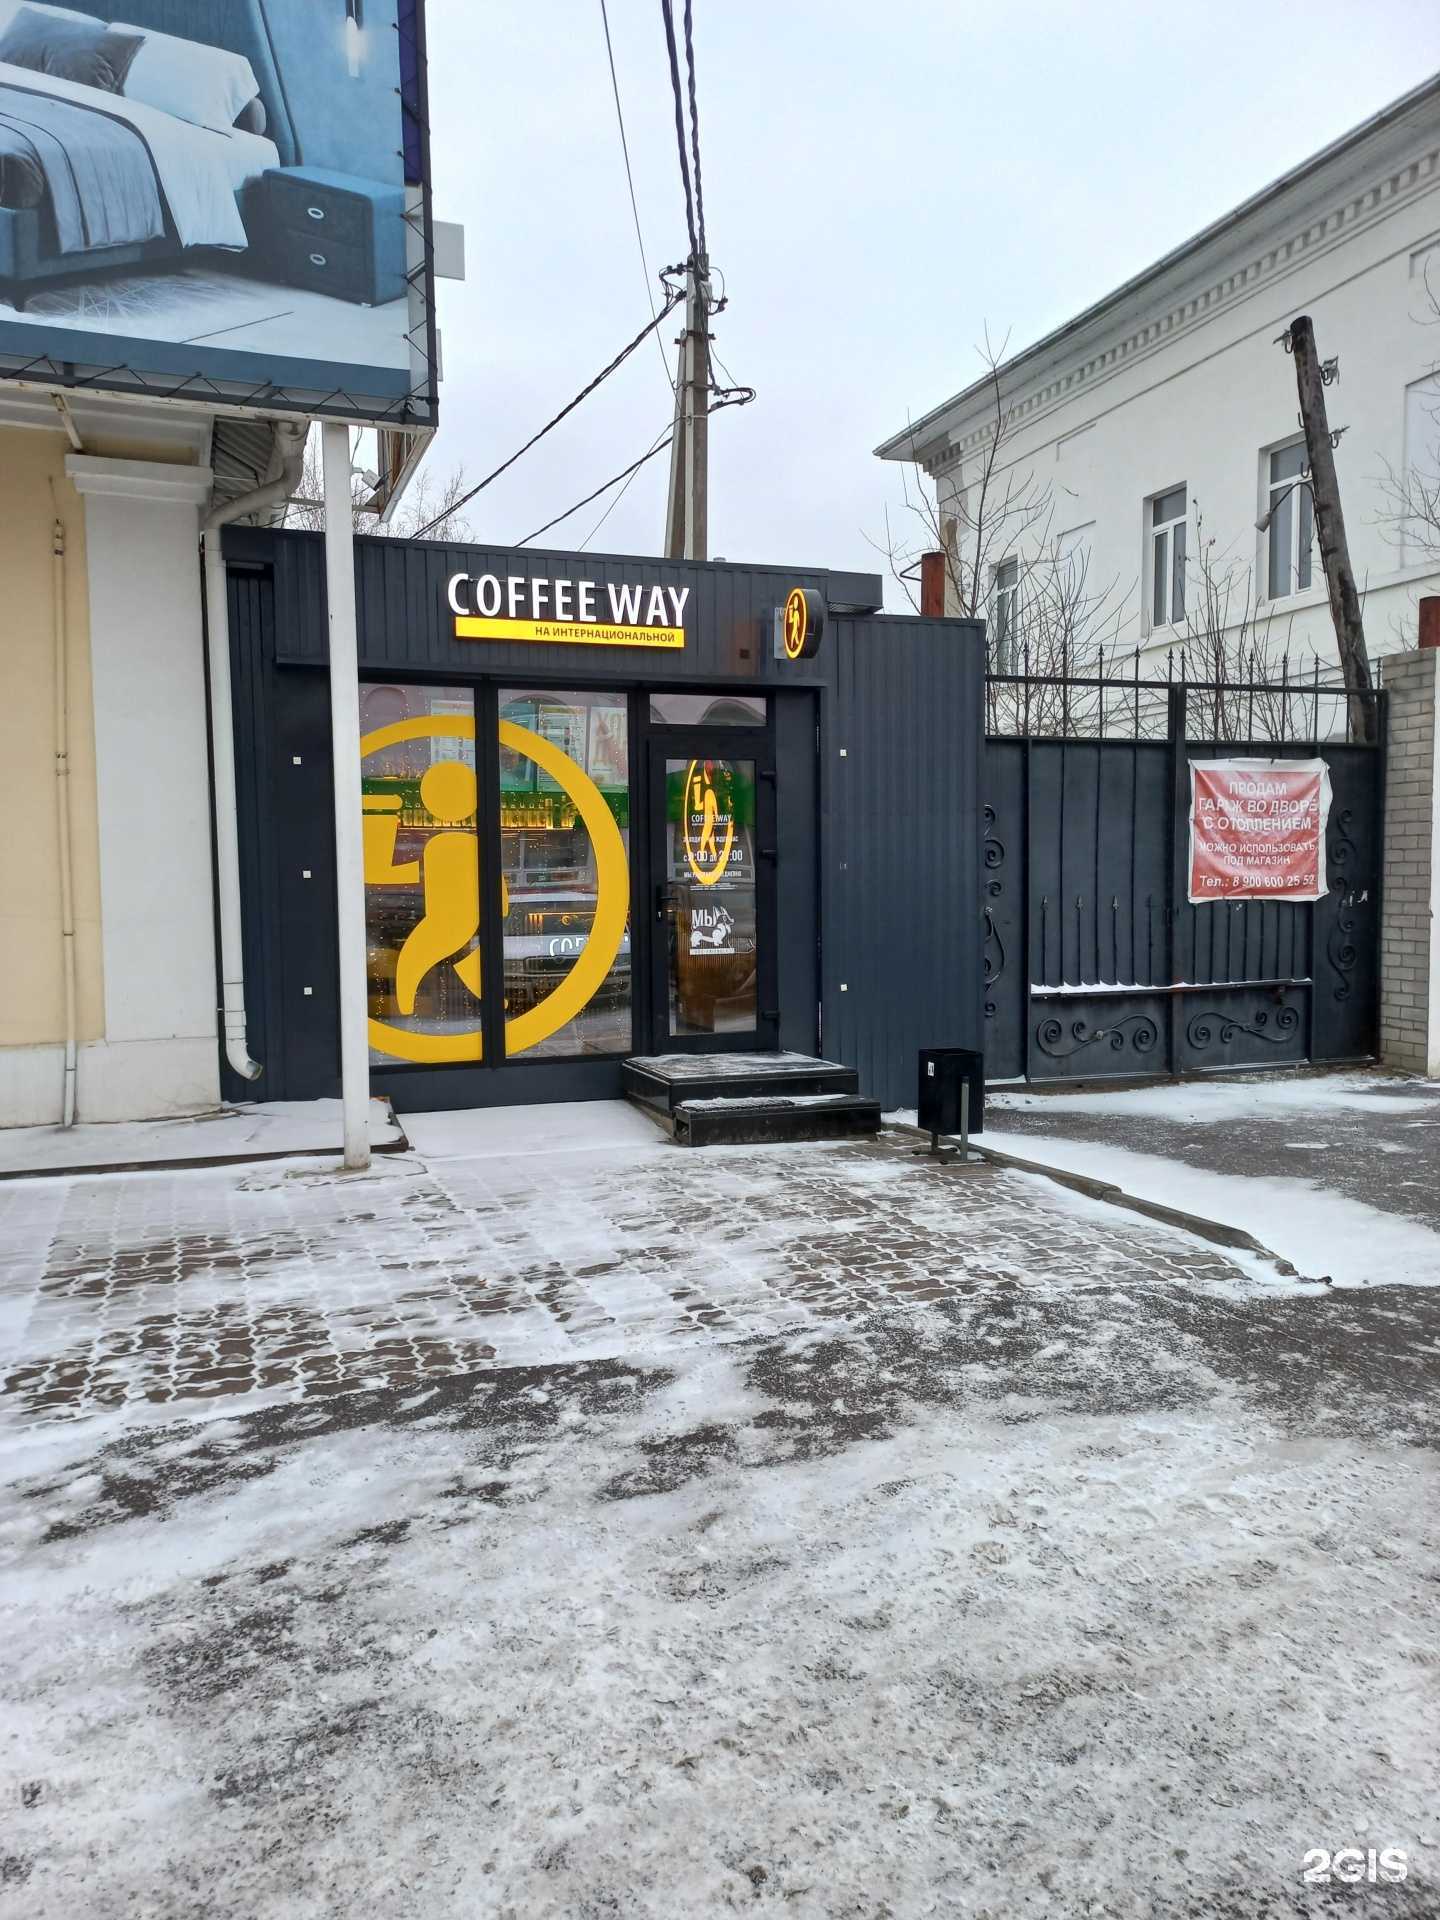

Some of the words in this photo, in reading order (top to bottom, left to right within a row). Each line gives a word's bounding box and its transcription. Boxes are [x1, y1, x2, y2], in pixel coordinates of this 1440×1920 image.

[447, 573, 597, 622] COFFEE
[607, 583, 690, 627] WAY
[535, 627, 551, 637] НА
[552, 627, 675, 643] ИНТЕРНАЦИОНАЛЬНОЙ
[1229, 781, 1287, 795] ПРОДАМ
[1199, 798, 1243, 812] ГАРЖ
[1247, 800, 1267, 813] ВО
[1269, 799, 1318, 815] ДВОРЕ
[1217, 816, 1312, 831] ОТОПЛЕНИЕМ
[1199, 842, 1237, 853] МОЖНО
[1239, 841, 1315, 854] ИСПОЛЬЗОВАТЬ
[1223, 856, 1244, 866] ПОД
[1246, 855, 1291, 866] МАГАЗИН
[1232, 875, 1240, 887] 8
[1243, 875, 1261, 888] 900
[1287, 875, 1301, 887] 25
